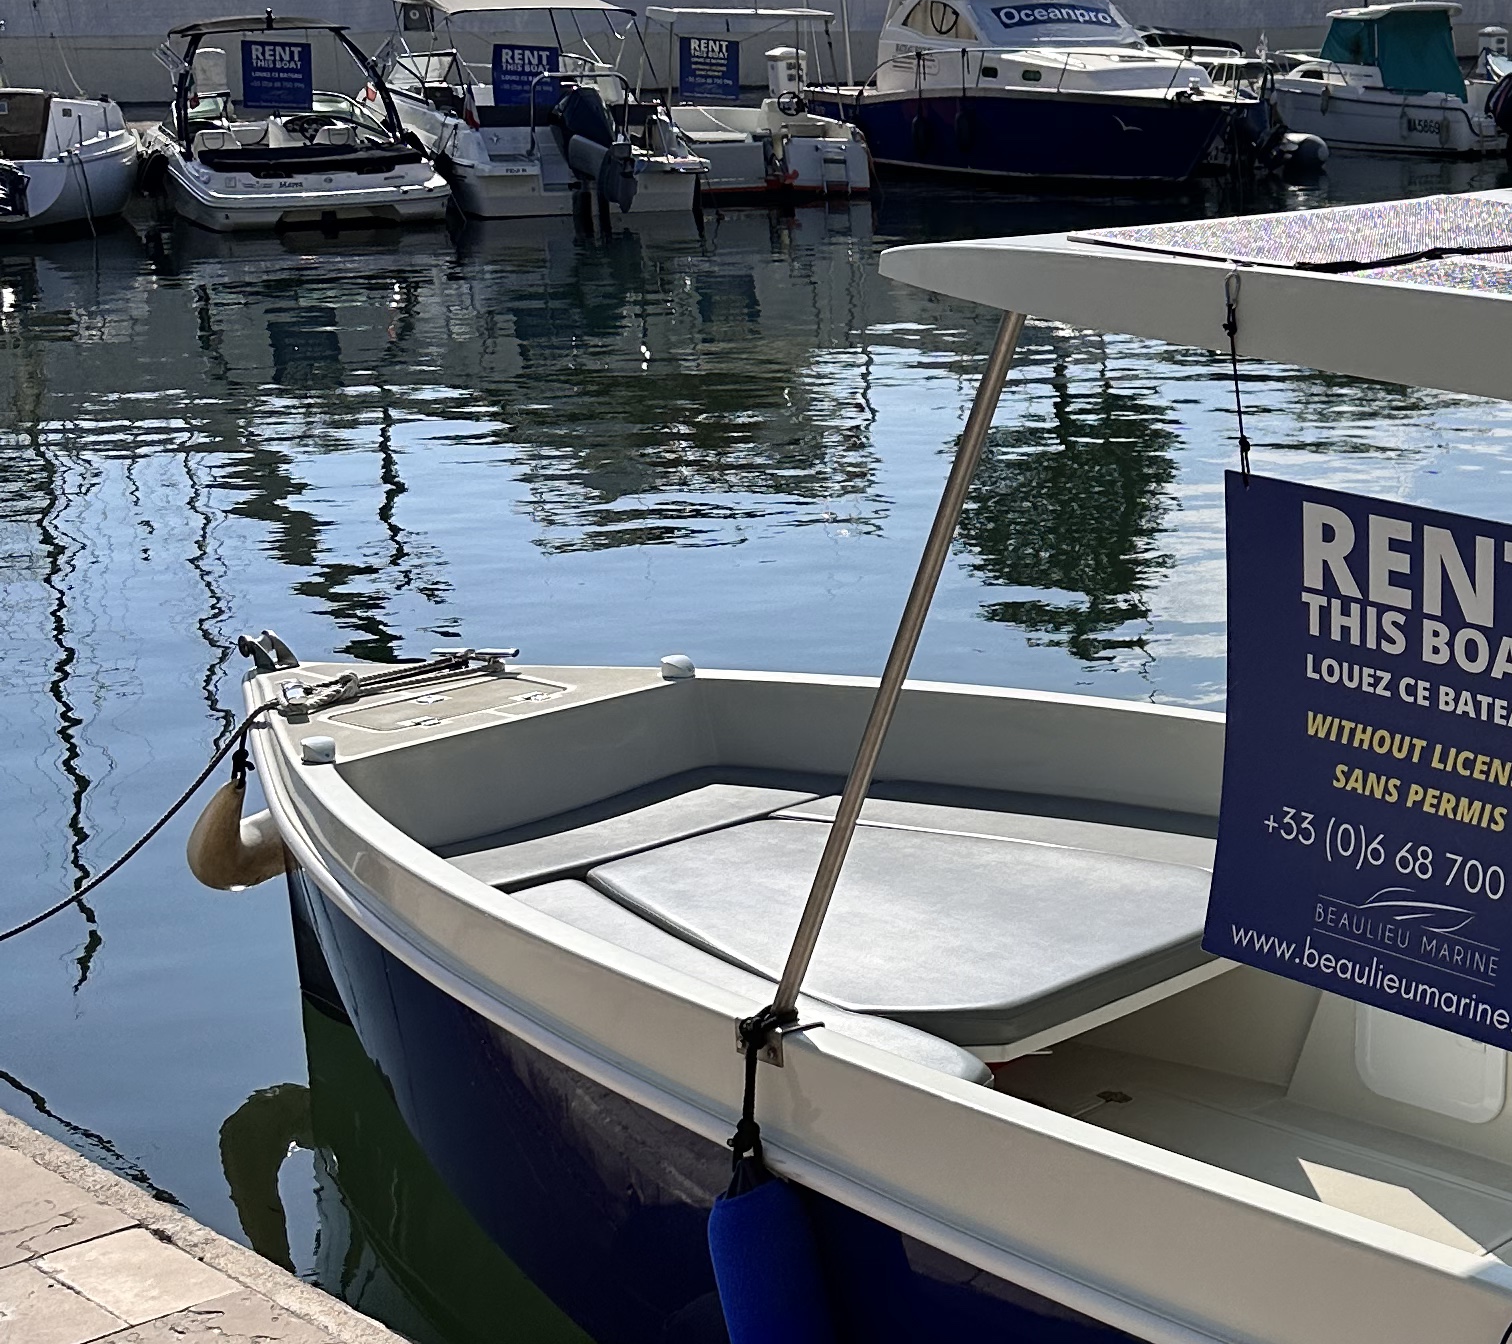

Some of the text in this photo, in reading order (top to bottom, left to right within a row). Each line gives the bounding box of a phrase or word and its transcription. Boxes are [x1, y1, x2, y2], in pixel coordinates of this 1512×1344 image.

[999, 7, 1112, 24] Oceanpro
[251, 44, 302, 62] RENT
[252, 59, 302, 69] THIS BOAT
[501, 48, 550, 65] RENT
[690, 38, 729, 53] RENT
[1301, 592, 1407, 655] THIS
[1306, 654, 1392, 698] LOUEZ
[1399, 676, 1431, 707] CE
[1307, 710, 1428, 764] WITHOUT
[1332, 763, 1508, 832] SANS PERMIS
[1263, 806, 1316, 846] +33
[1325, 817, 1385, 870] (0)6
[1395, 841, 1433, 880] 68
[1445, 853, 1505, 900] 700
[1314, 902, 1499, 977] BEAULIEU MARINE
